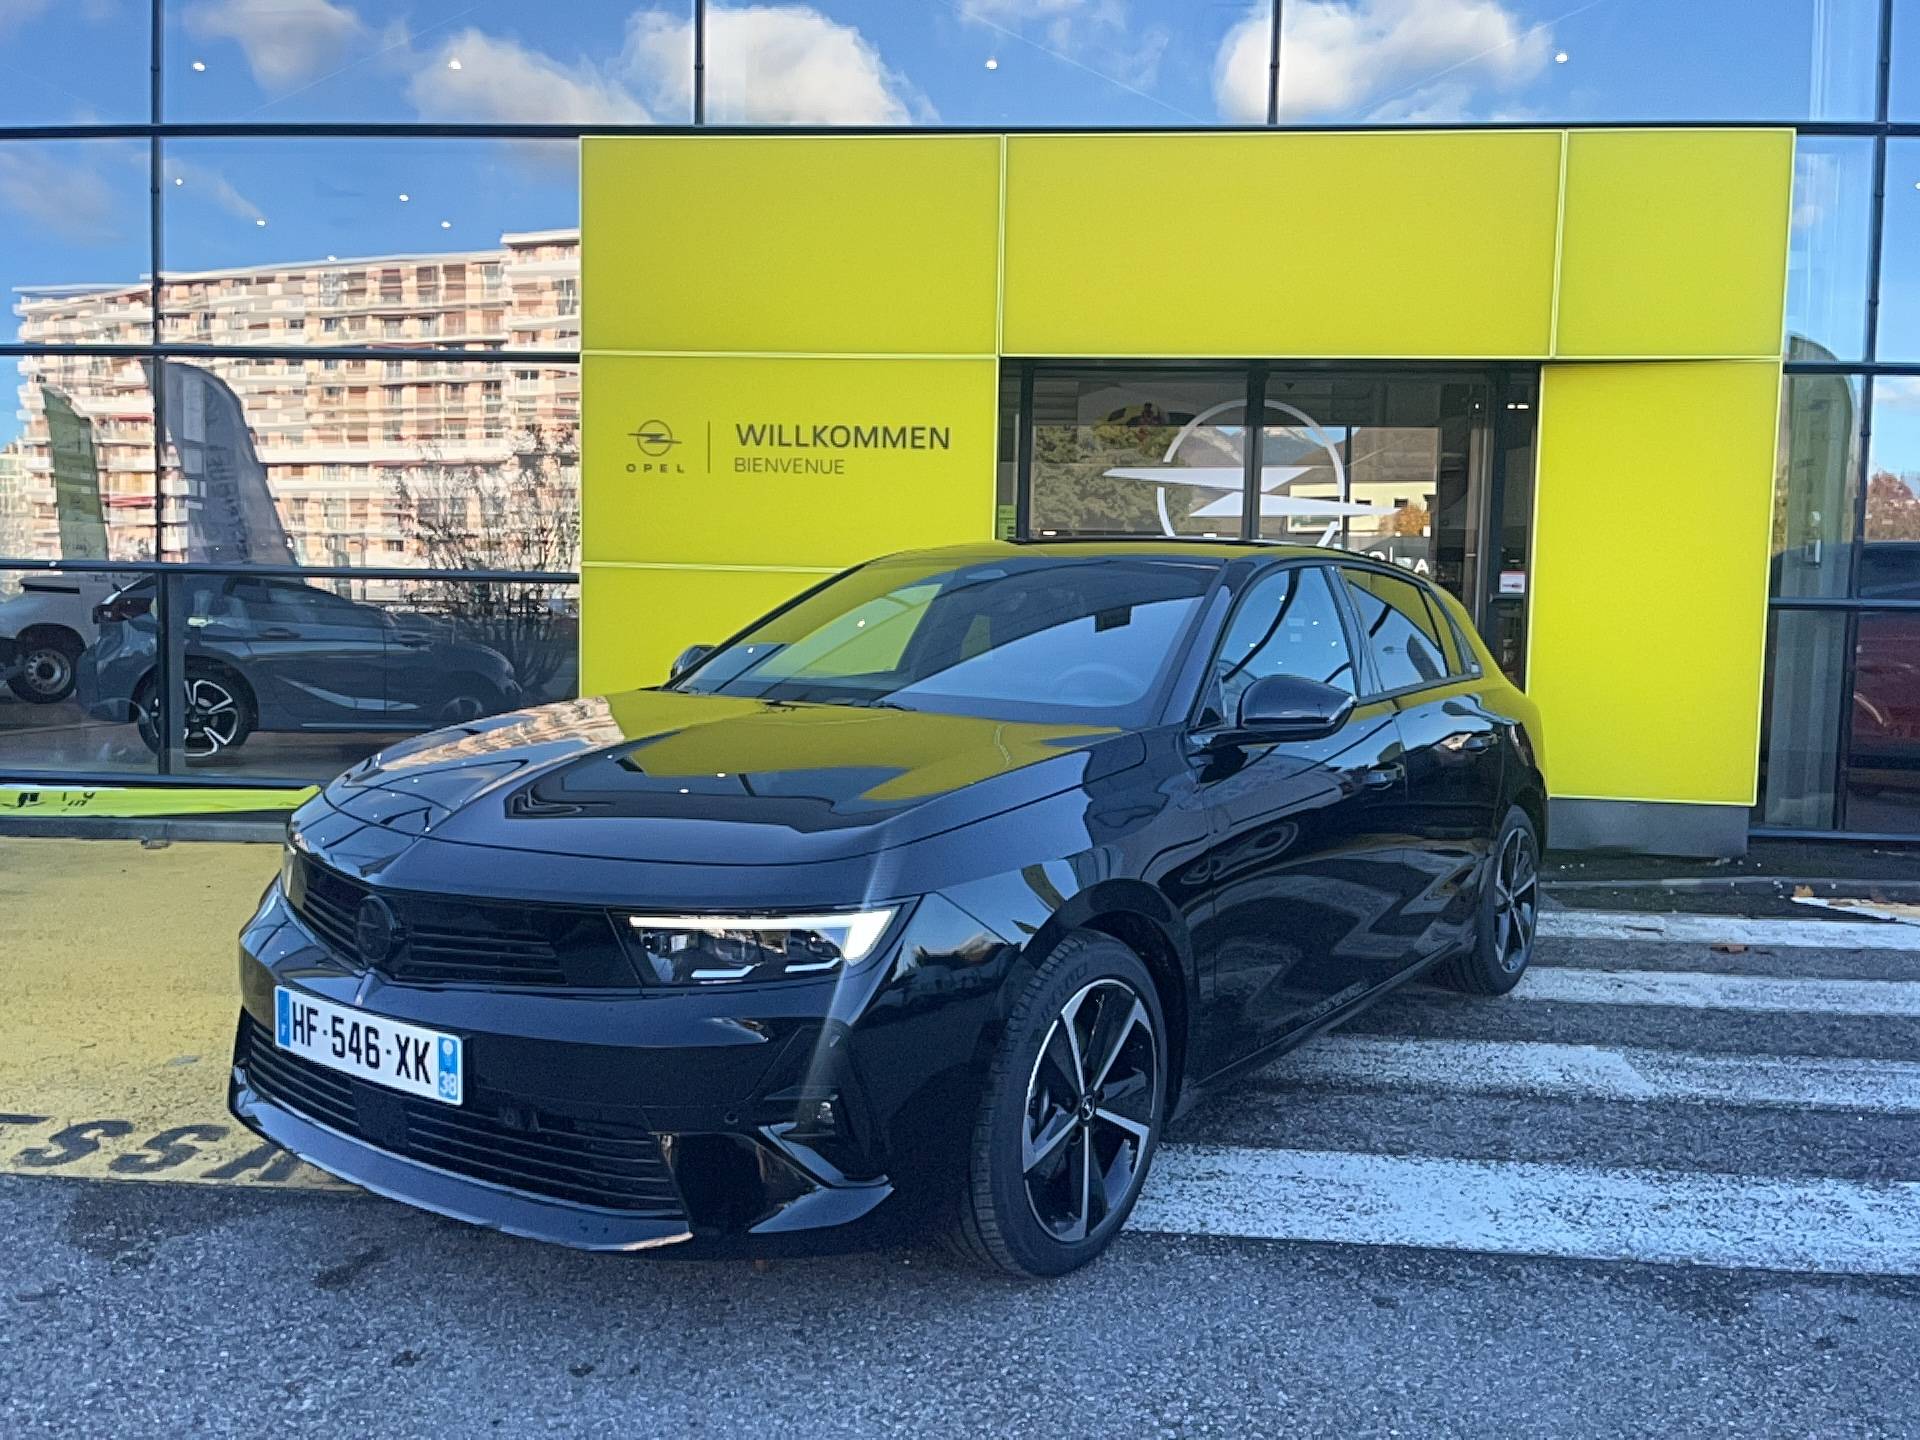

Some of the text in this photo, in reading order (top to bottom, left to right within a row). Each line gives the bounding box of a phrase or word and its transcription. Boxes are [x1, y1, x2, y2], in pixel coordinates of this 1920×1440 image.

[735, 423, 951, 450] WILLKOMMEN
[625, 463, 685, 474] OPEL
[734, 457, 846, 475] BIENVENUE
[292, 1001, 432, 1085] HF-546-XK
[439, 1070, 458, 1097] 38
